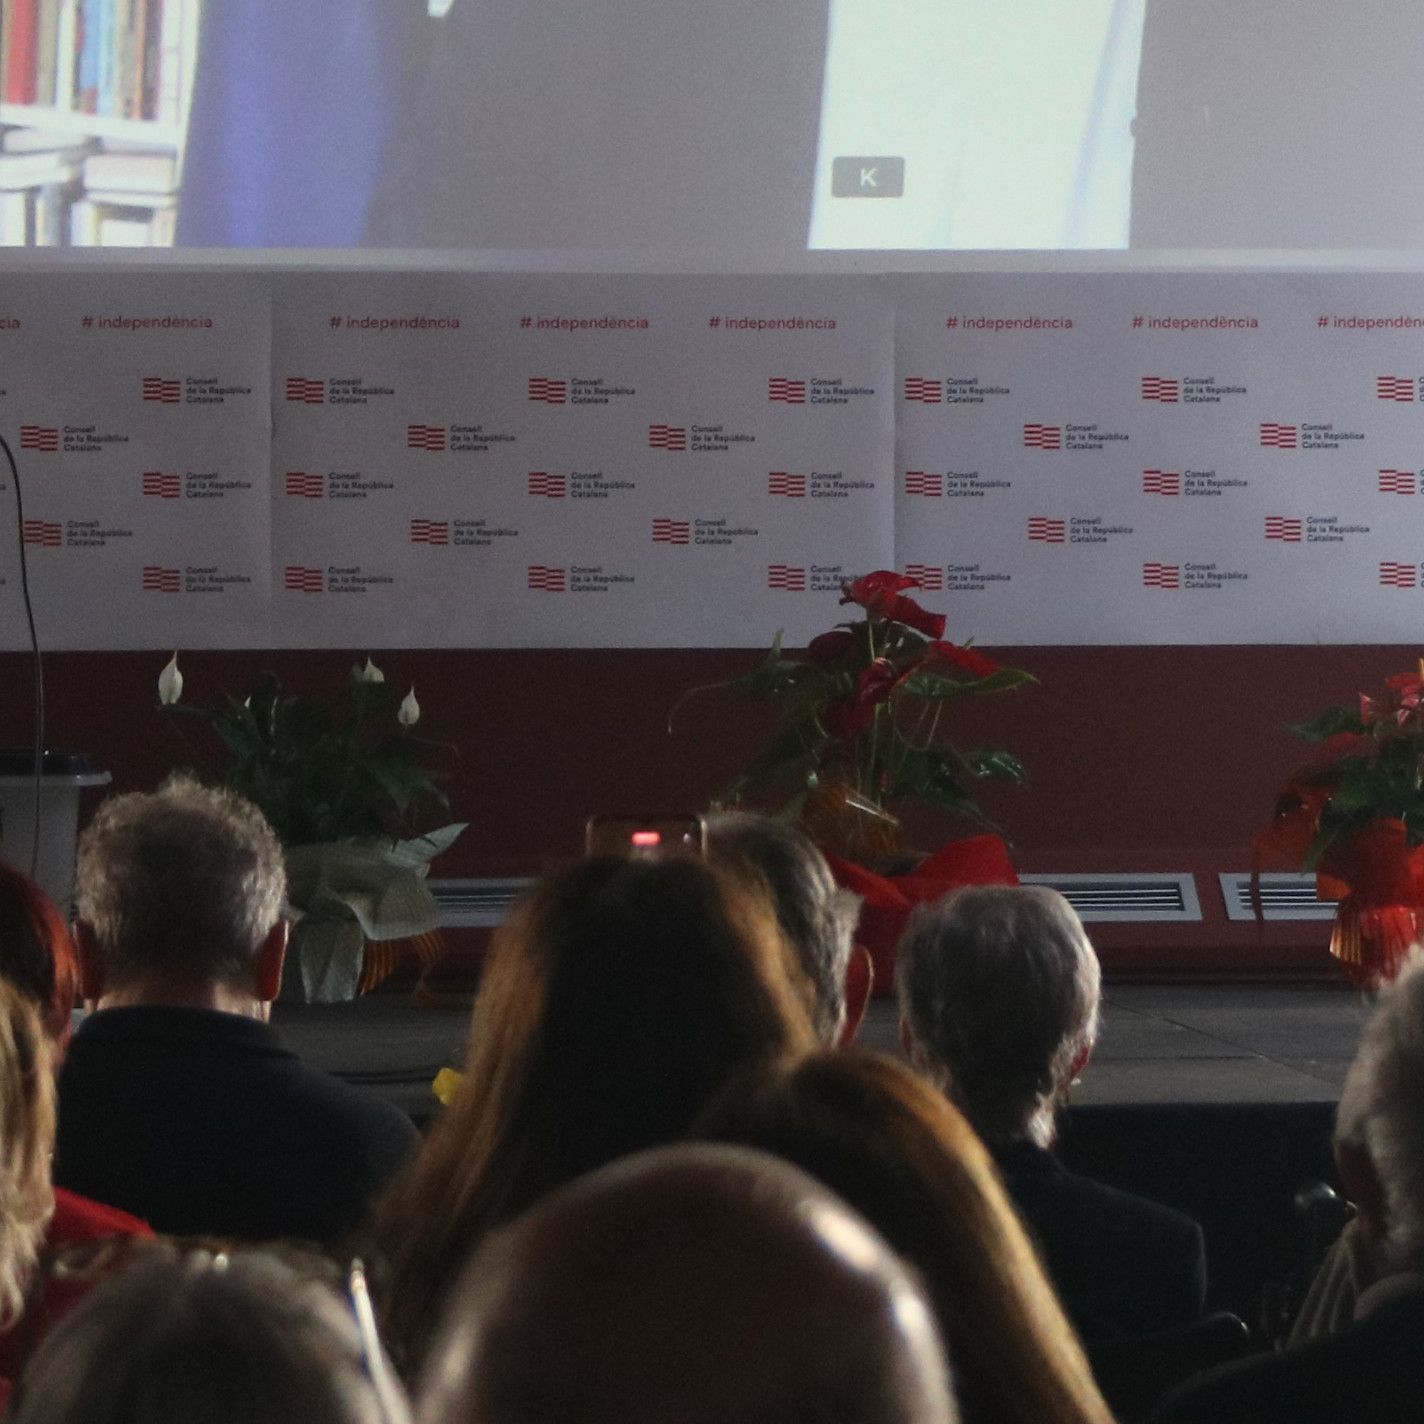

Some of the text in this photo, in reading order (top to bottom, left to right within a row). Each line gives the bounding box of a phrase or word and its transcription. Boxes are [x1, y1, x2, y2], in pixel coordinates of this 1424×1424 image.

[860, 168, 878, 186] K
[82, 315, 213, 331] # independència
[330, 316, 460, 331] # independència
[521, 316, 649, 331] # independència
[709, 316, 837, 332] # independència
[947, 316, 1073, 331] # independència
[1132, 315, 1259, 331] # independència
[1318, 316, 1329, 328] #
[329, 377, 361, 385] Consell
[810, 378, 841, 386] Consell
[329, 396, 367, 404] Catalana
[811, 396, 847, 404] Catalana
[1183, 395, 1221, 403] Catalana
[450, 425, 481, 433] Consell
[1301, 423, 1332, 431] Consell
[450, 443, 488, 451] Catalana
[691, 443, 728, 451] Catalana
[1066, 442, 1103, 450] Catalana
[1302, 441, 1338, 449] Catalana
[570, 472, 602, 480] Consell
[1184, 470, 1215, 478] Consell
[571, 490, 608, 498] Catalana
[1185, 488, 1221, 496] Catalana
[1306, 516, 1338, 524] Consell
[695, 537, 732, 545] Catalana
[1307, 534, 1344, 542] Catalana
